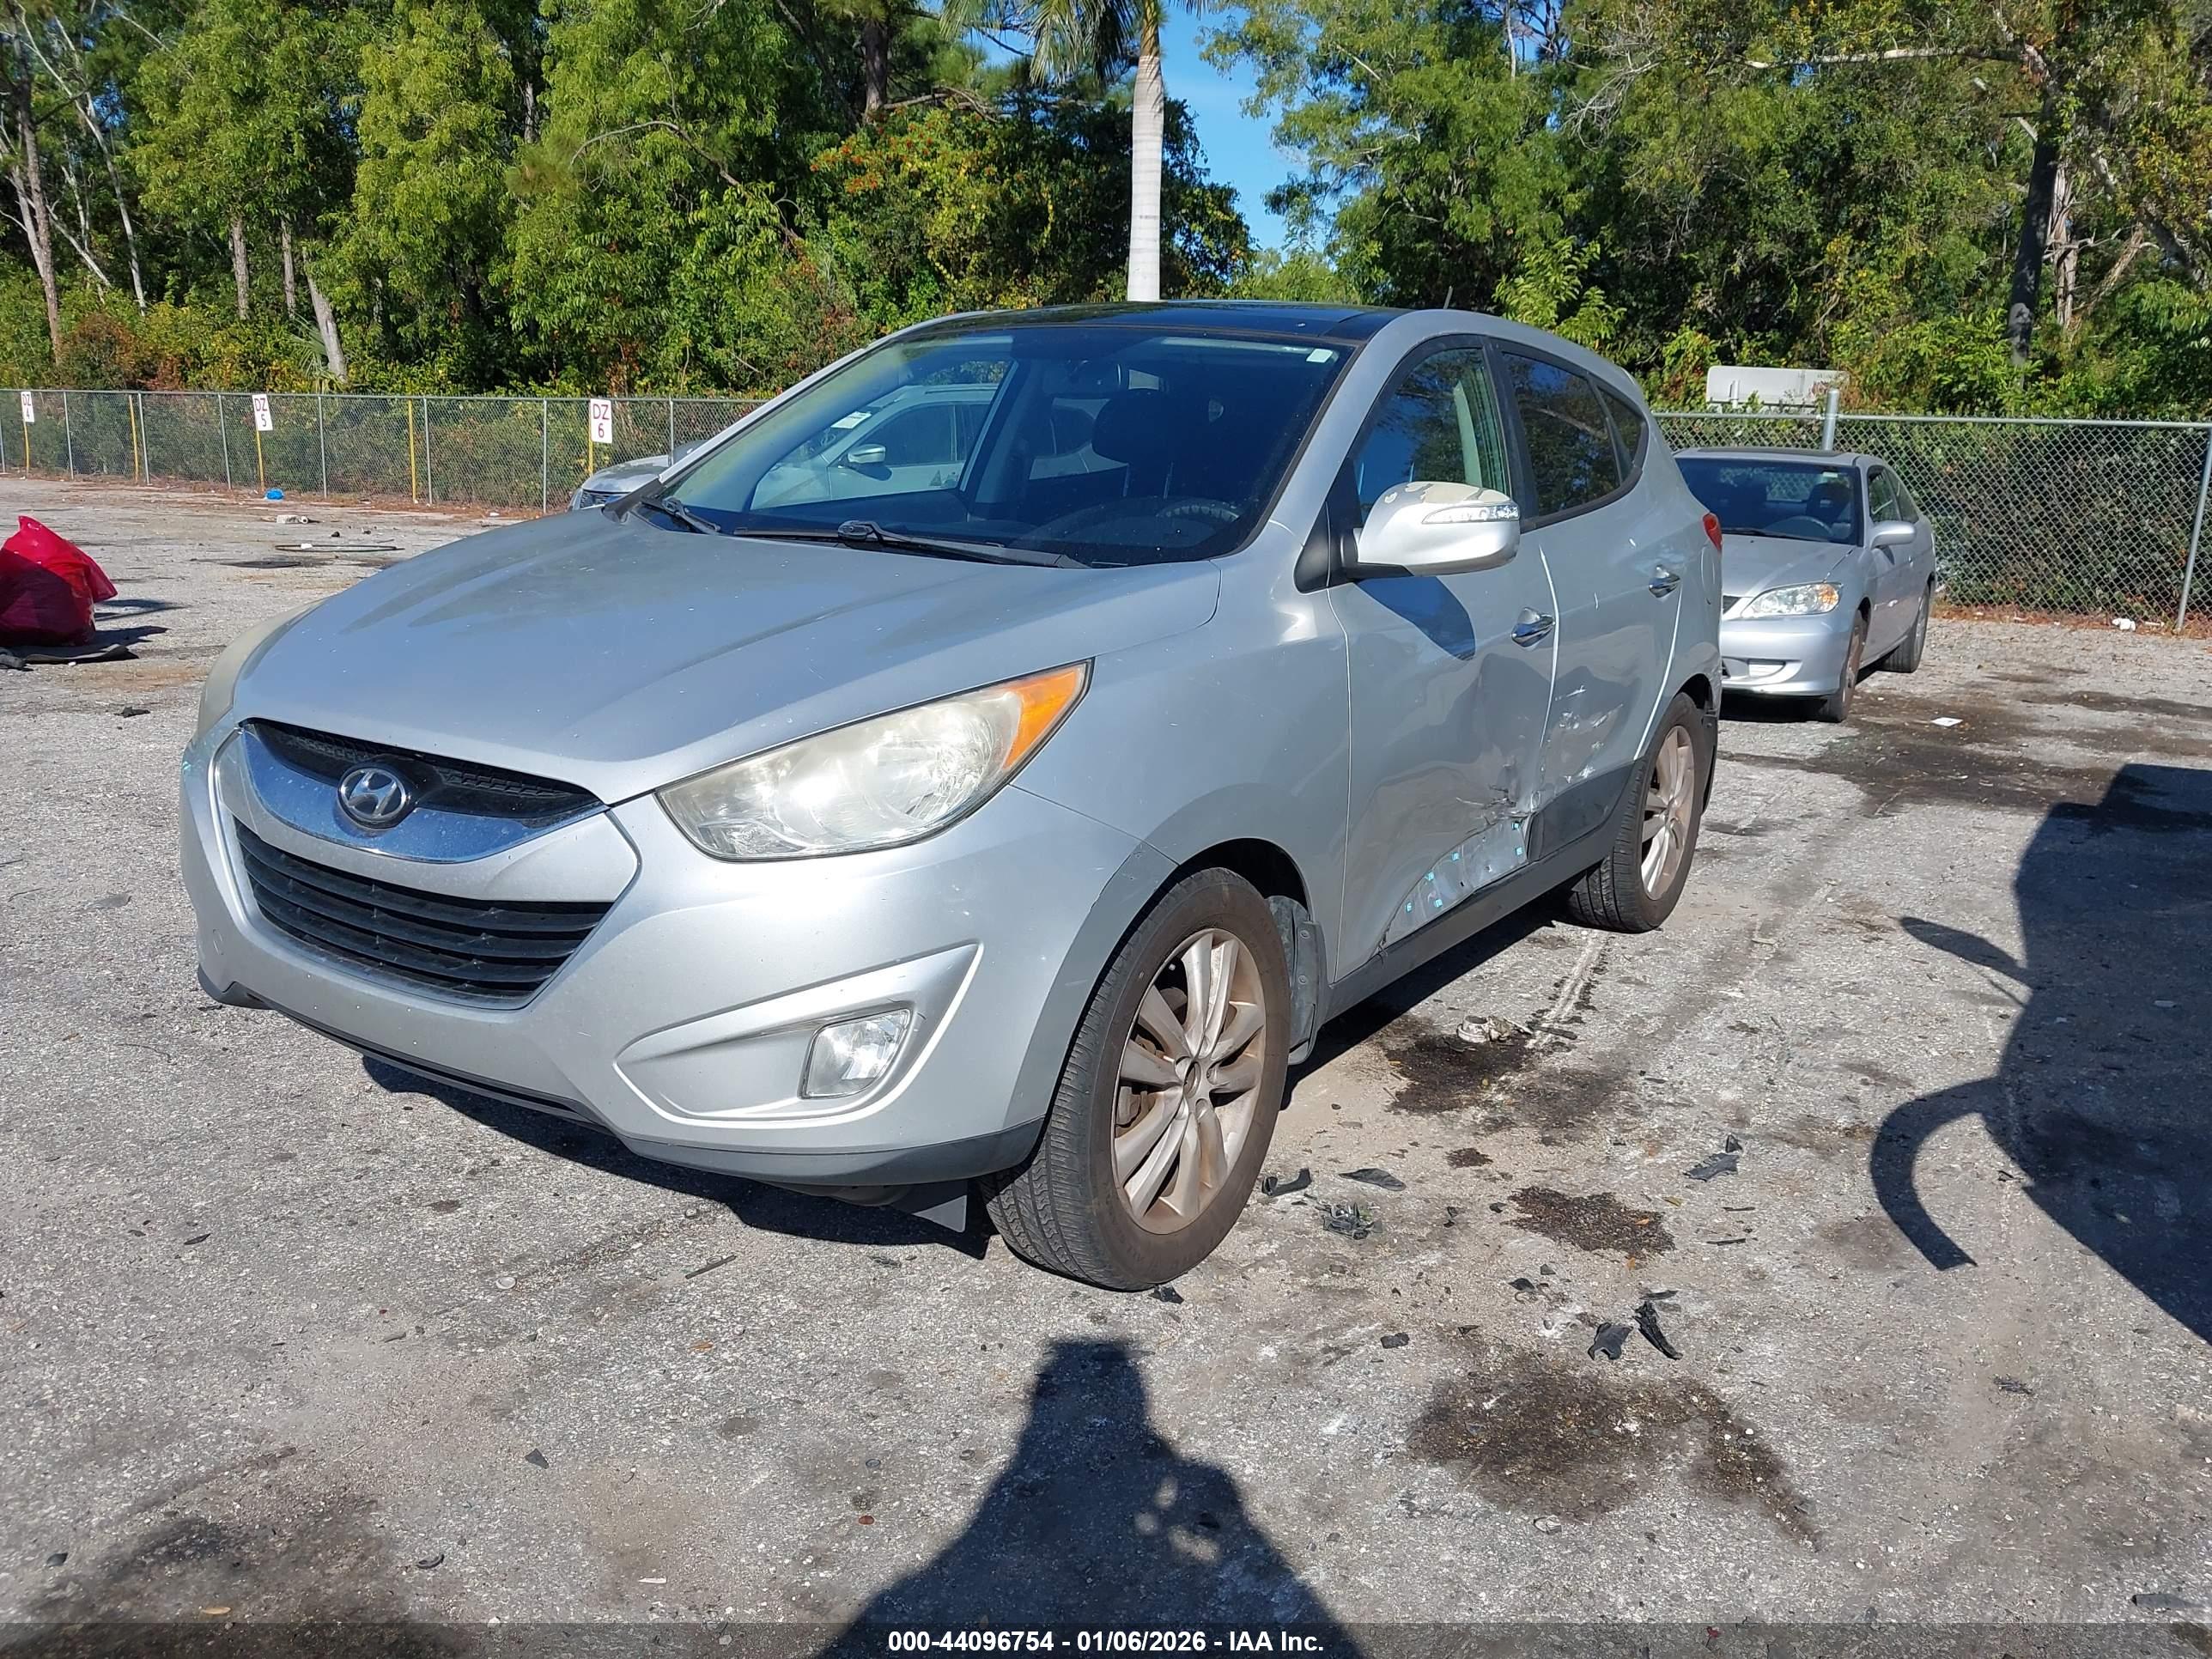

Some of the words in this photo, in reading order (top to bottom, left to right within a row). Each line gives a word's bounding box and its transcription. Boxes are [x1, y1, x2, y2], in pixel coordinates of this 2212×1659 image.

[253, 398, 268, 412] DZ
[592, 403, 610, 421] DZ
[598, 422, 605, 439] 6
